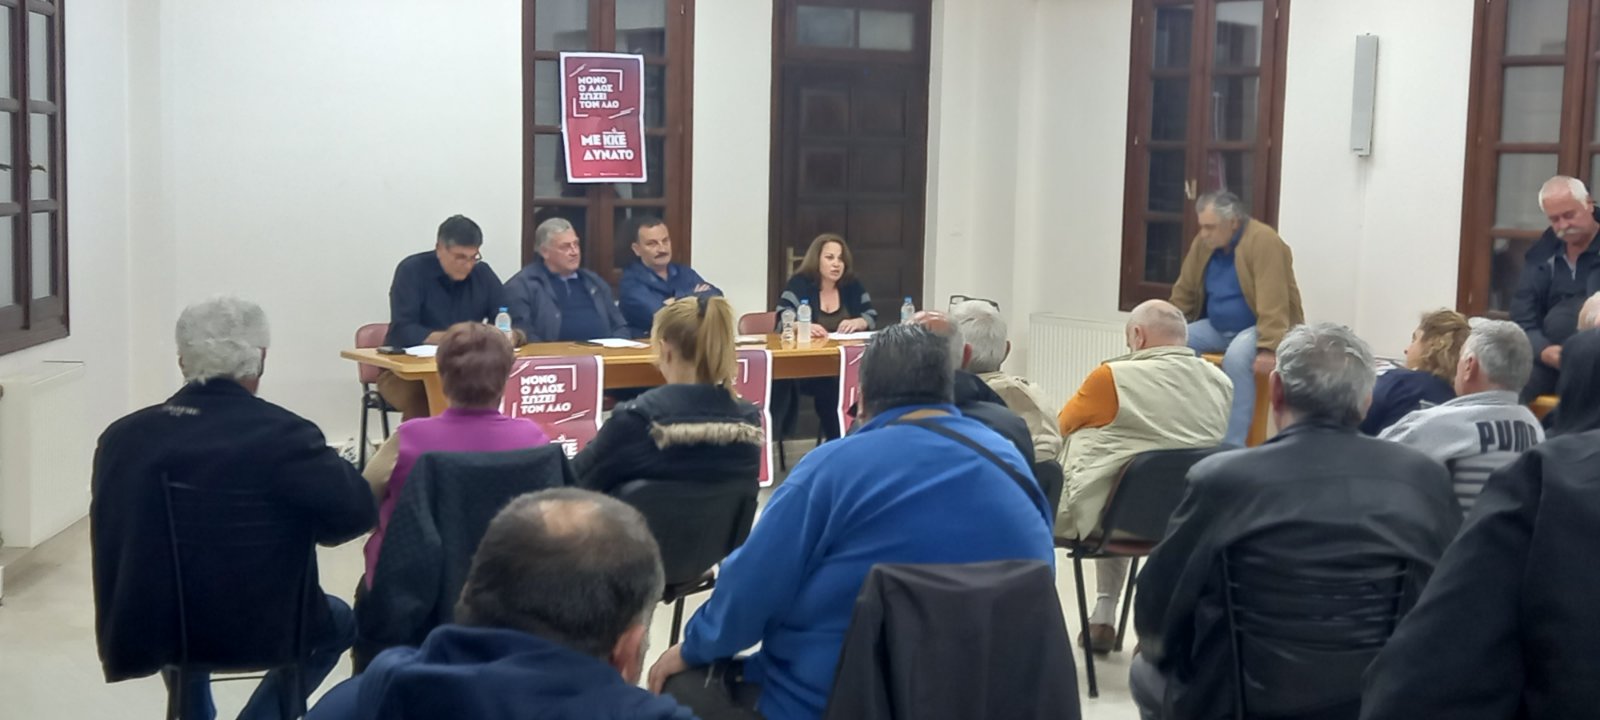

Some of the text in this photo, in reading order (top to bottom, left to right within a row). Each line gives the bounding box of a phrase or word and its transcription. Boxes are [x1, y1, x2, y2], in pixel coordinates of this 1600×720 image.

[578, 76, 607, 84] ΜΟΝΟ
[578, 84, 613, 92] Ο ΛΑΟΣ
[579, 100, 619, 108] ΤΟΝ ΛΑΟ
[580, 134, 601, 146] ΜΕ
[583, 149, 634, 160] ΔΥΝΑΤΟ
[520, 374, 557, 385] ΜΟΝΟ
[520, 383, 565, 394] Ο ΛΑΟΣ
[520, 402, 571, 414] ΤΟΝ ΛΑΟ
